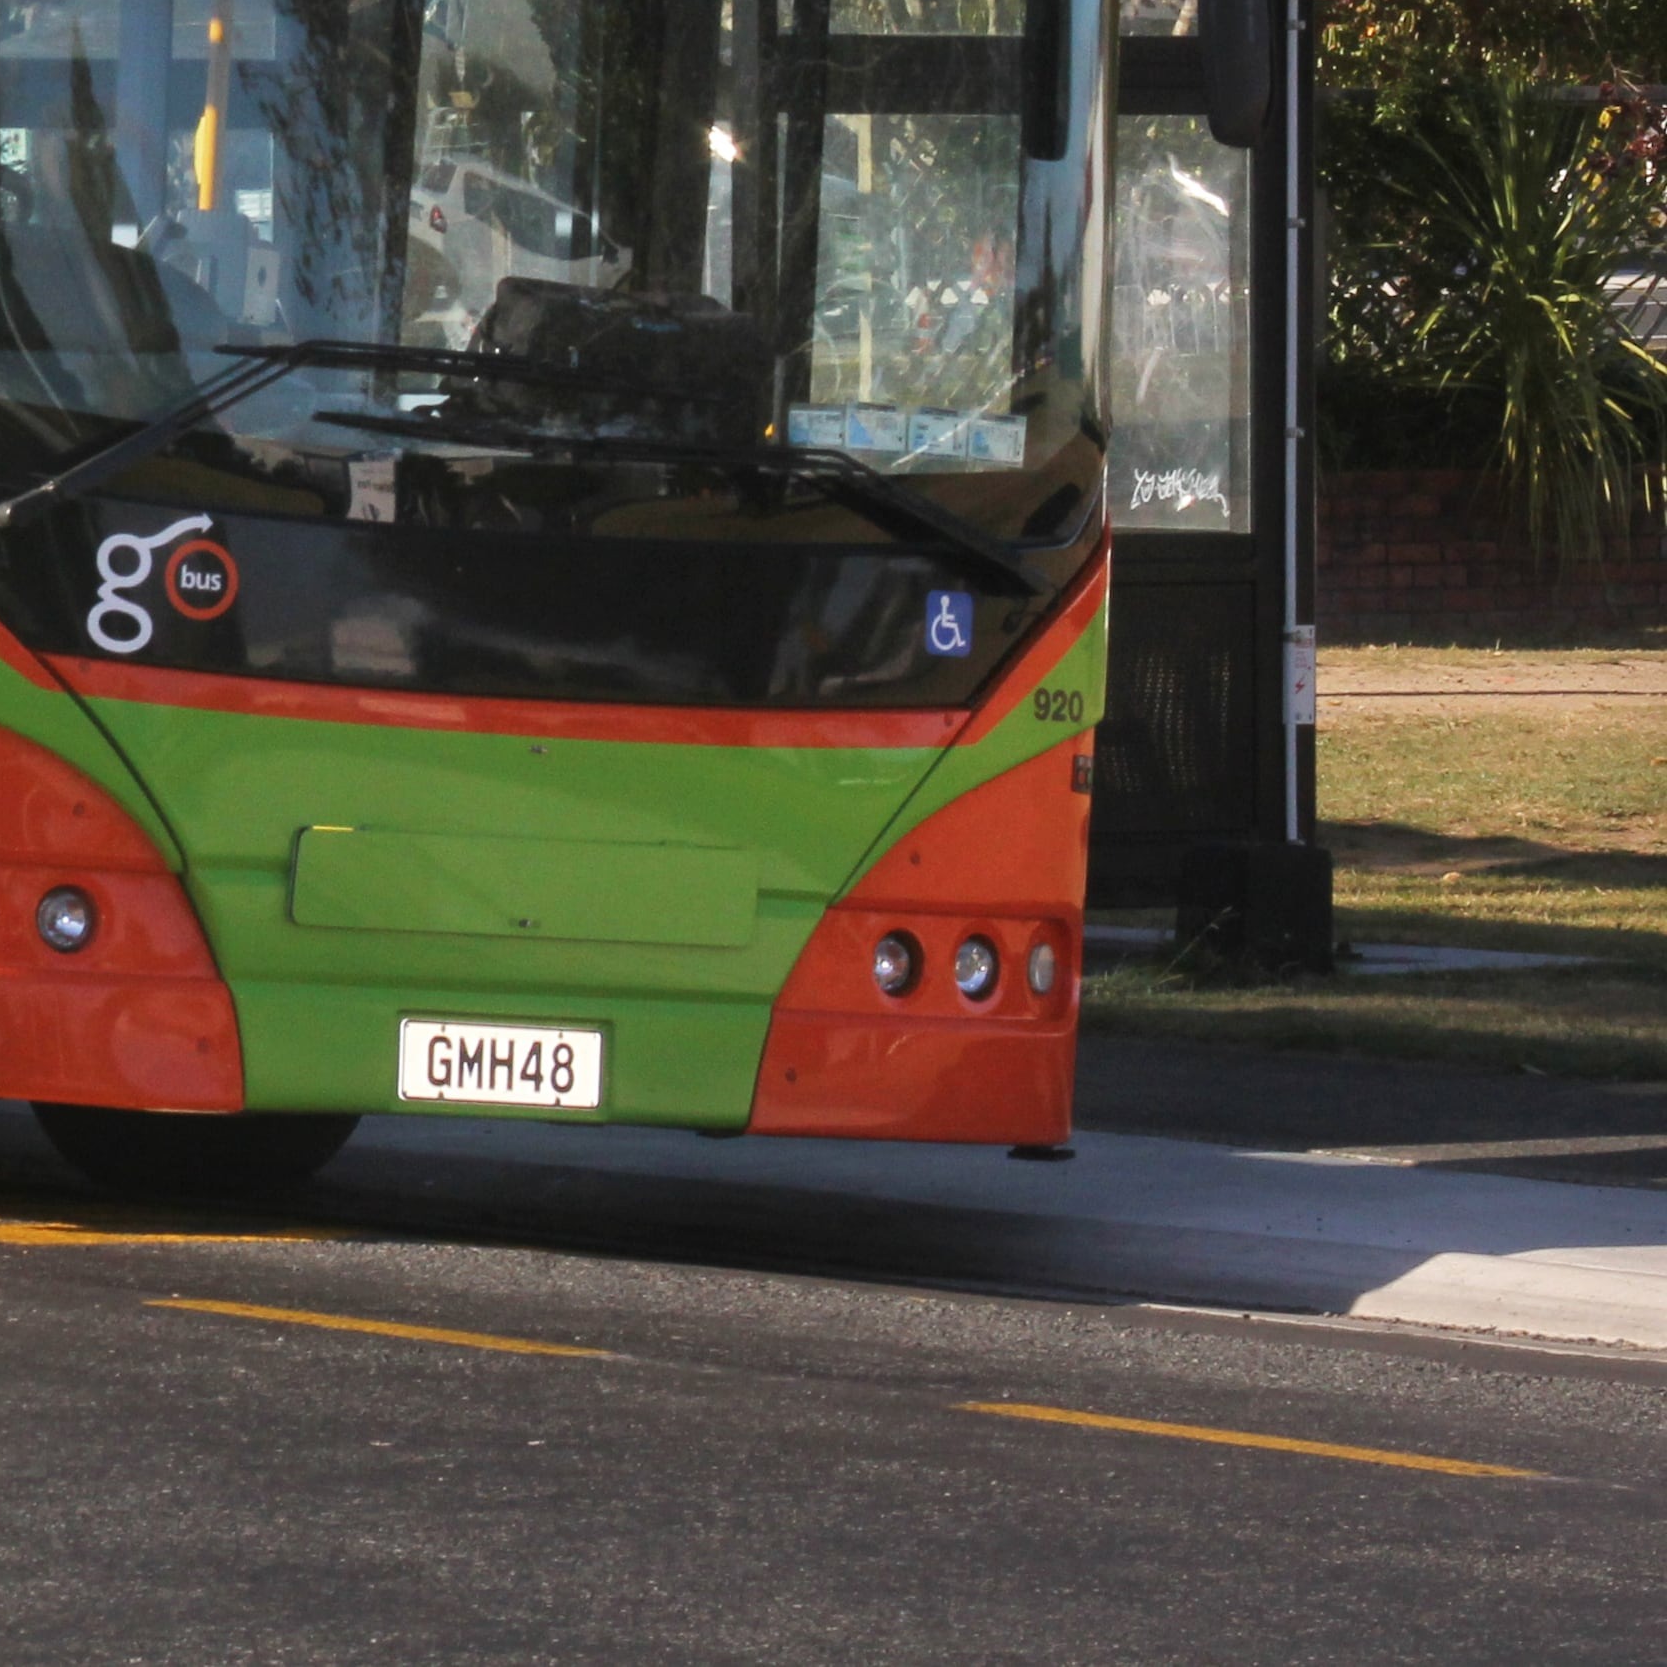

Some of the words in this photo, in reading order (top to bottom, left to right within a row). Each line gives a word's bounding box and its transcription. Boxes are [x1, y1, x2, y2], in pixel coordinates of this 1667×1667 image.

[180, 565, 222, 592] bus
[1033, 688, 1085, 723] 920
[427, 1035, 576, 1094] GMH48
